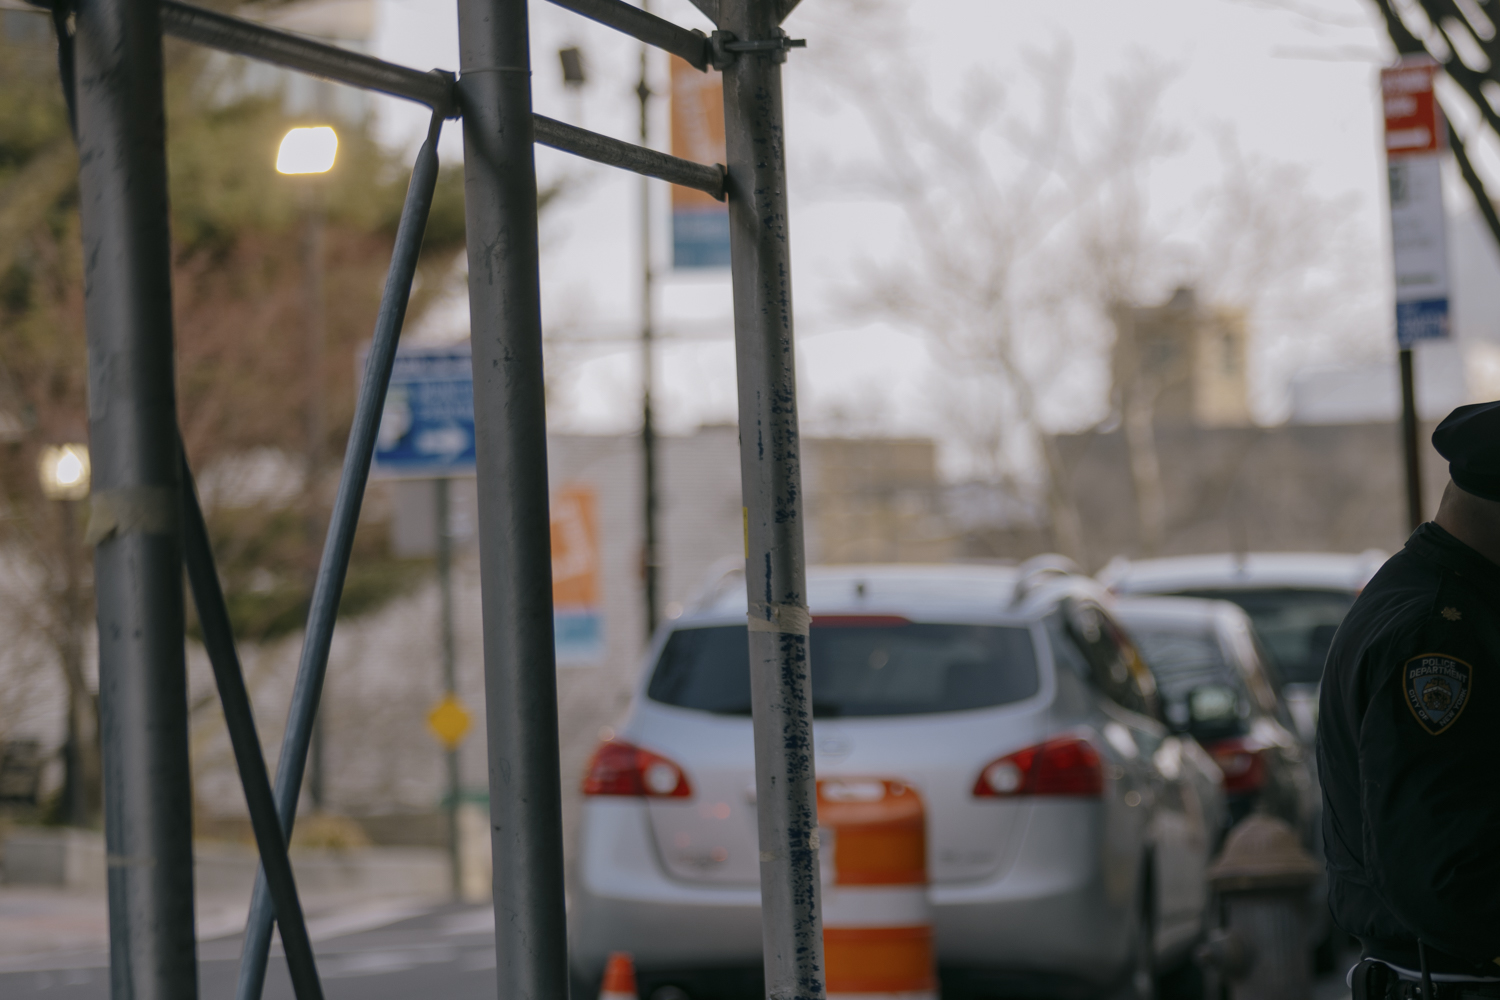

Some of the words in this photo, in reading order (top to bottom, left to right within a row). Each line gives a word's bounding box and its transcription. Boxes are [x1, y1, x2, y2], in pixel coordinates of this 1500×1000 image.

[1409, 665, 1467, 683] DEPARTMENT
[1422, 658, 1456, 669] POLICE
[1408, 689, 1420, 708] CITY
[1418, 709, 1429, 721] OF
[1439, 709, 1455, 726] NEW
[1453, 687, 1467, 709] YORK
